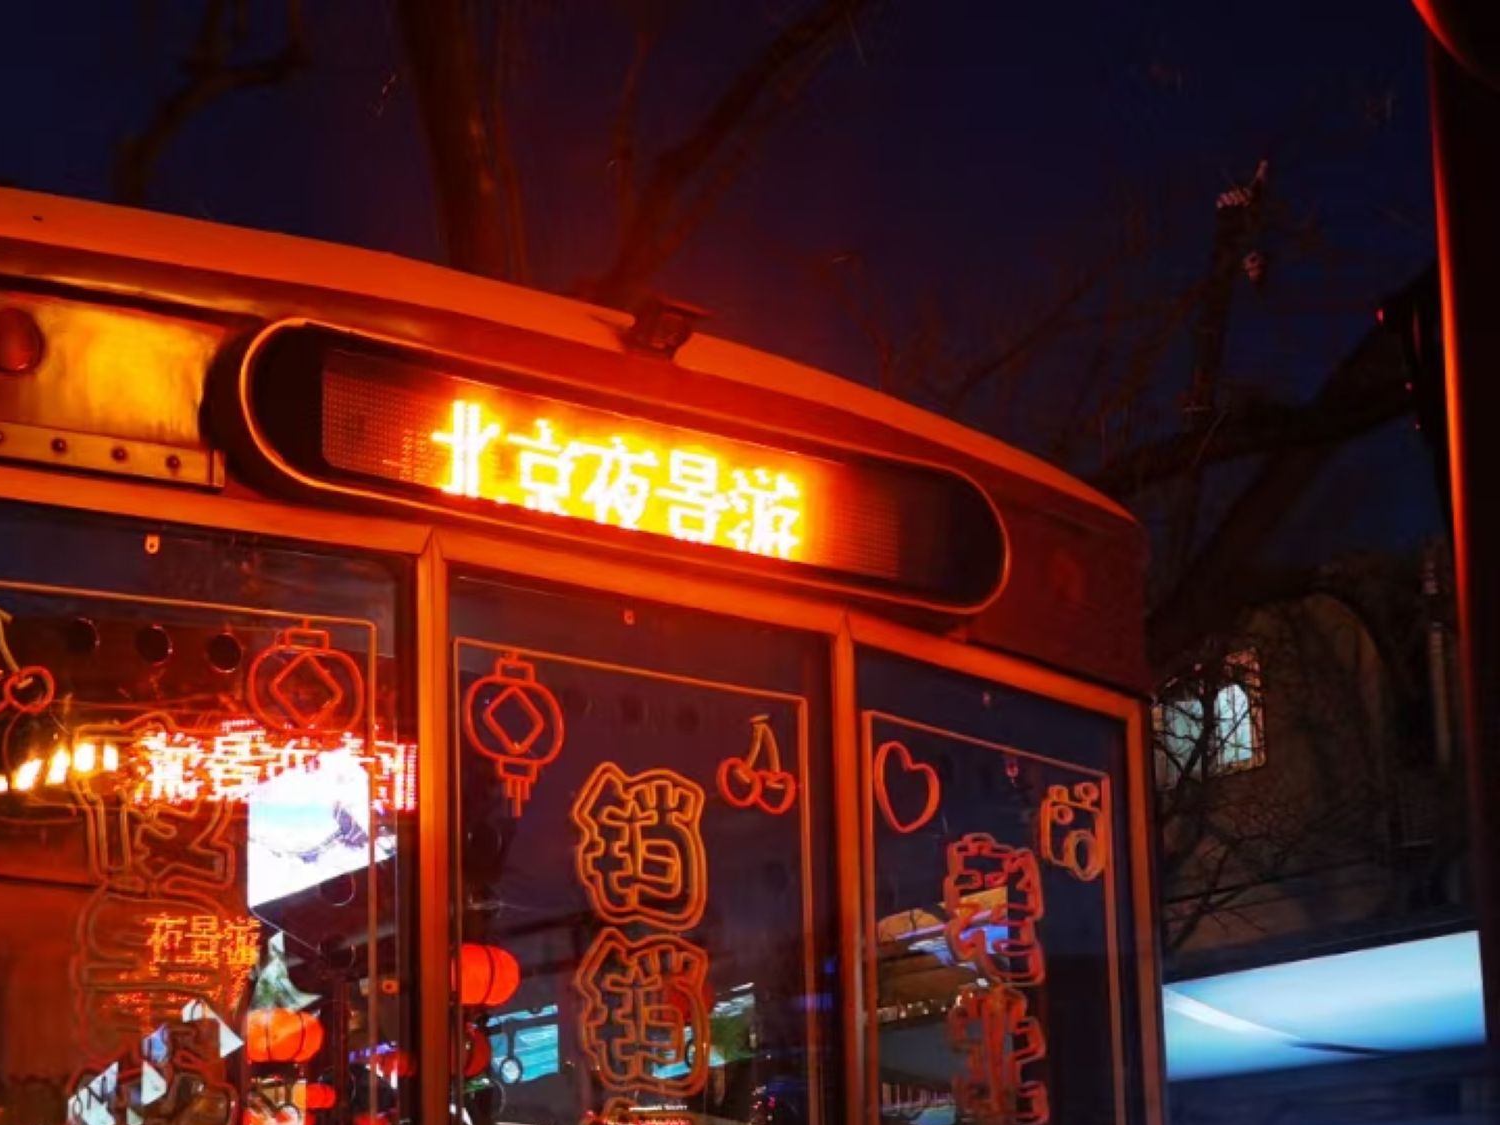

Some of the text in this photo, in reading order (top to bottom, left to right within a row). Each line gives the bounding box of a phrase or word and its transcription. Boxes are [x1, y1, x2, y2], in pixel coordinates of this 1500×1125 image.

[432, 400, 800, 560] 北京夜景游
